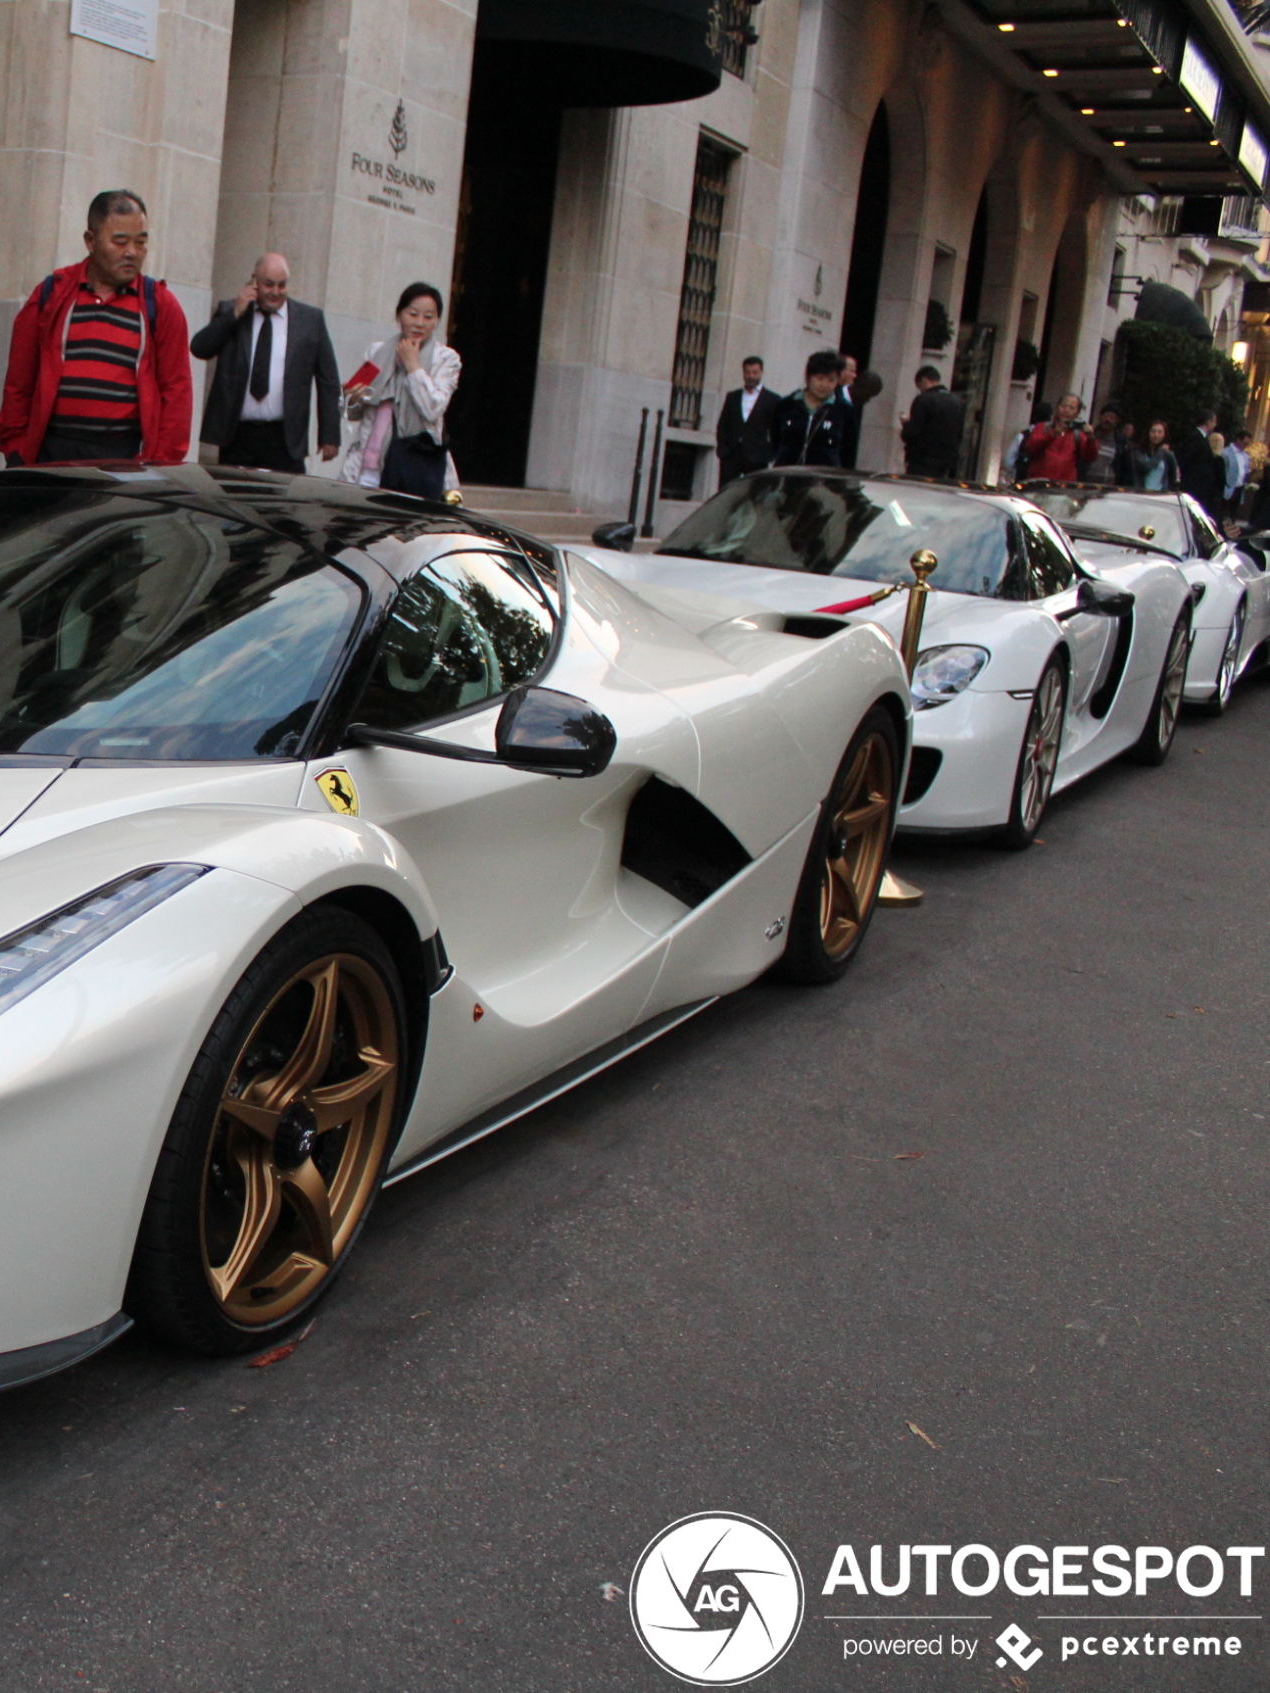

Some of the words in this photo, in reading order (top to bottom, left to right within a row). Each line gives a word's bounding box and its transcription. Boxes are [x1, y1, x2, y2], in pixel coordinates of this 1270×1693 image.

[351, 152, 383, 179] FOUR
[386, 164, 436, 195] SEASONS
[382, 186, 403, 199] HOTEL
